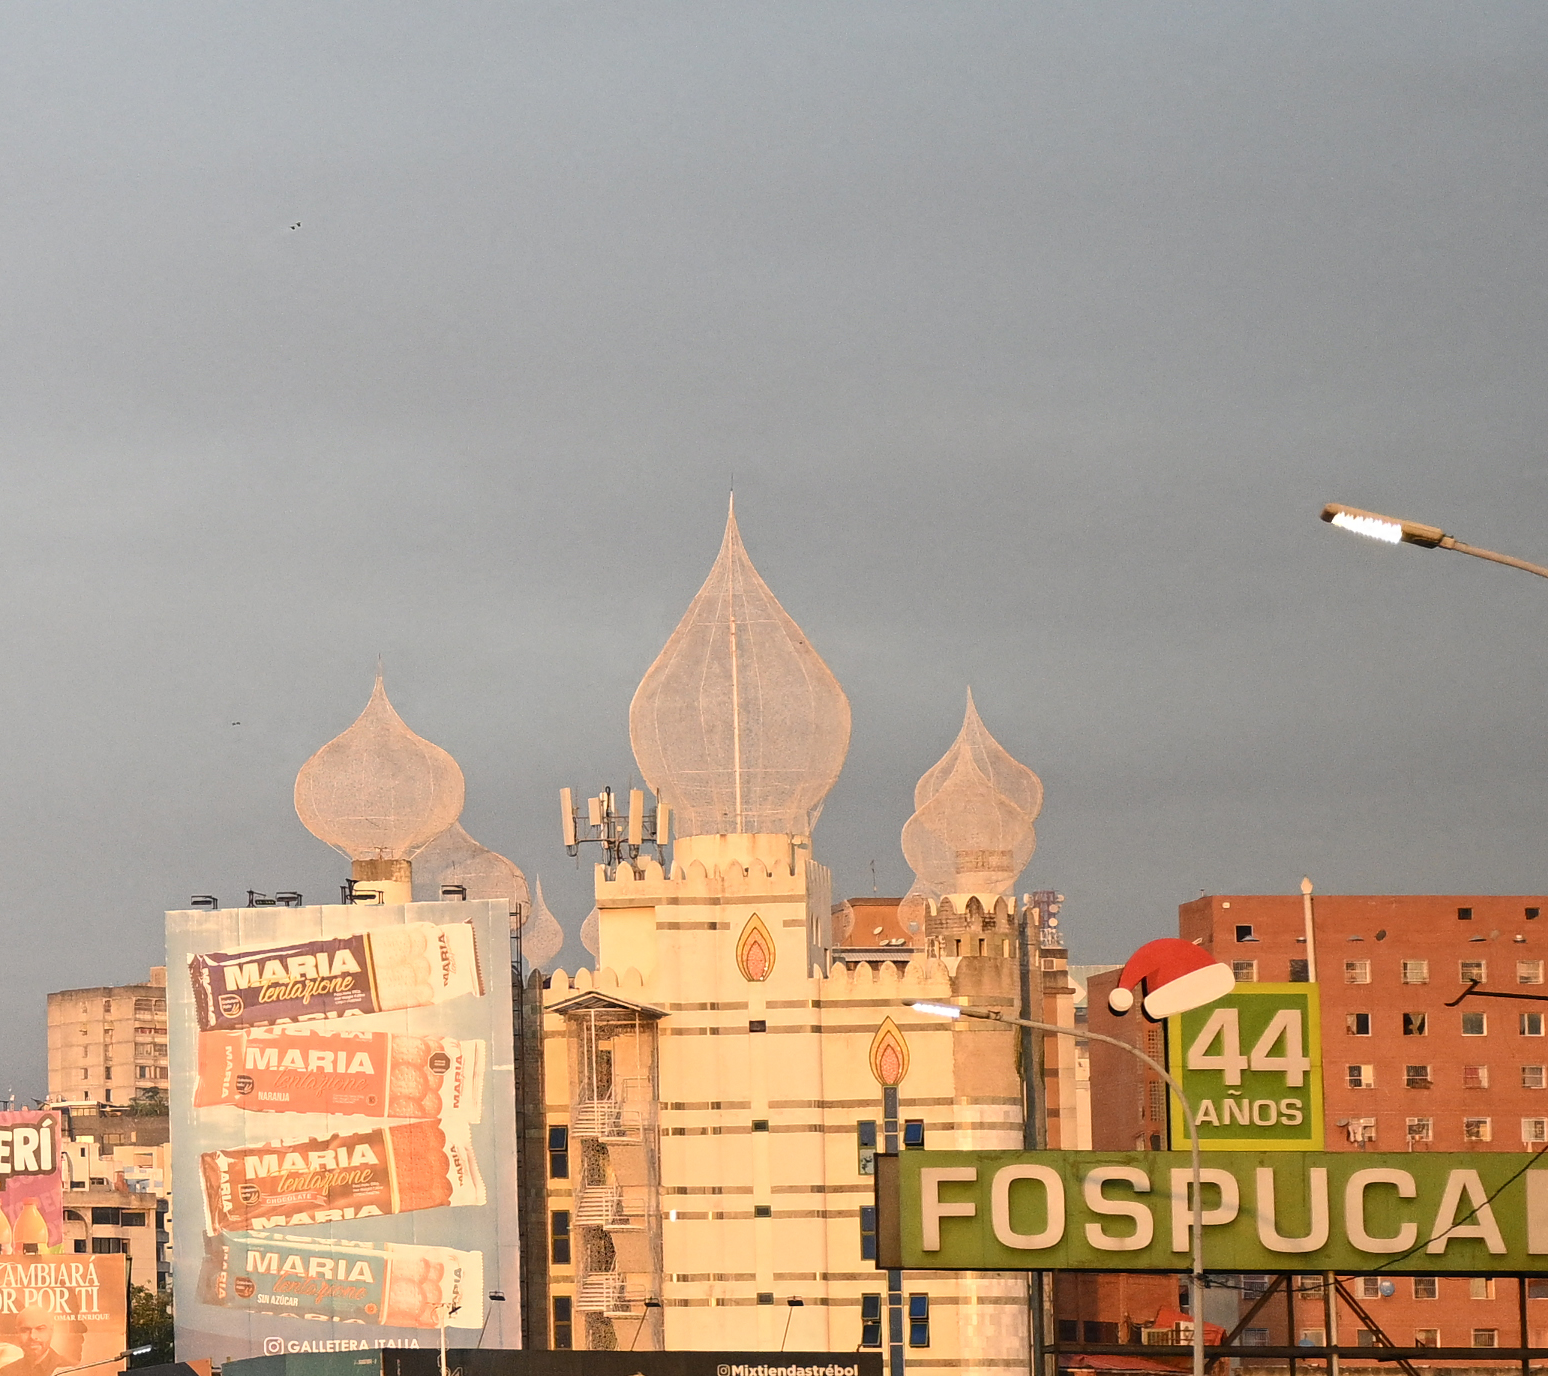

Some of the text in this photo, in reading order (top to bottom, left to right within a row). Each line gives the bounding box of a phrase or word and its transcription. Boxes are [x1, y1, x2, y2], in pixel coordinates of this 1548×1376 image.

[223, 948, 362, 991] MARIA
[436, 932, 450, 987] MARIA
[245, 1047, 375, 1075] MARIA
[1186, 1008, 1311, 1087] 44
[221, 1045, 233, 1099] MARIA
[452, 1053, 463, 1109] MARIA
[258, 1091, 290, 1102] NARANJA
[1194, 1088, 1304, 1127] AÑOS
[244, 1143, 380, 1180] MARIA
[266, 1193, 312, 1205] CHOCOLATE
[245, 1250, 375, 1284] MARIA
[23, 1287, 71, 1314] POR
[75, 1287, 100, 1313] TI
[77, 1313, 110, 1321] ENRIQUE
[257, 1293, 299, 1307] SIN AZÚCAR
[287, 1338, 420, 1354] GALLETERA ITALIA
